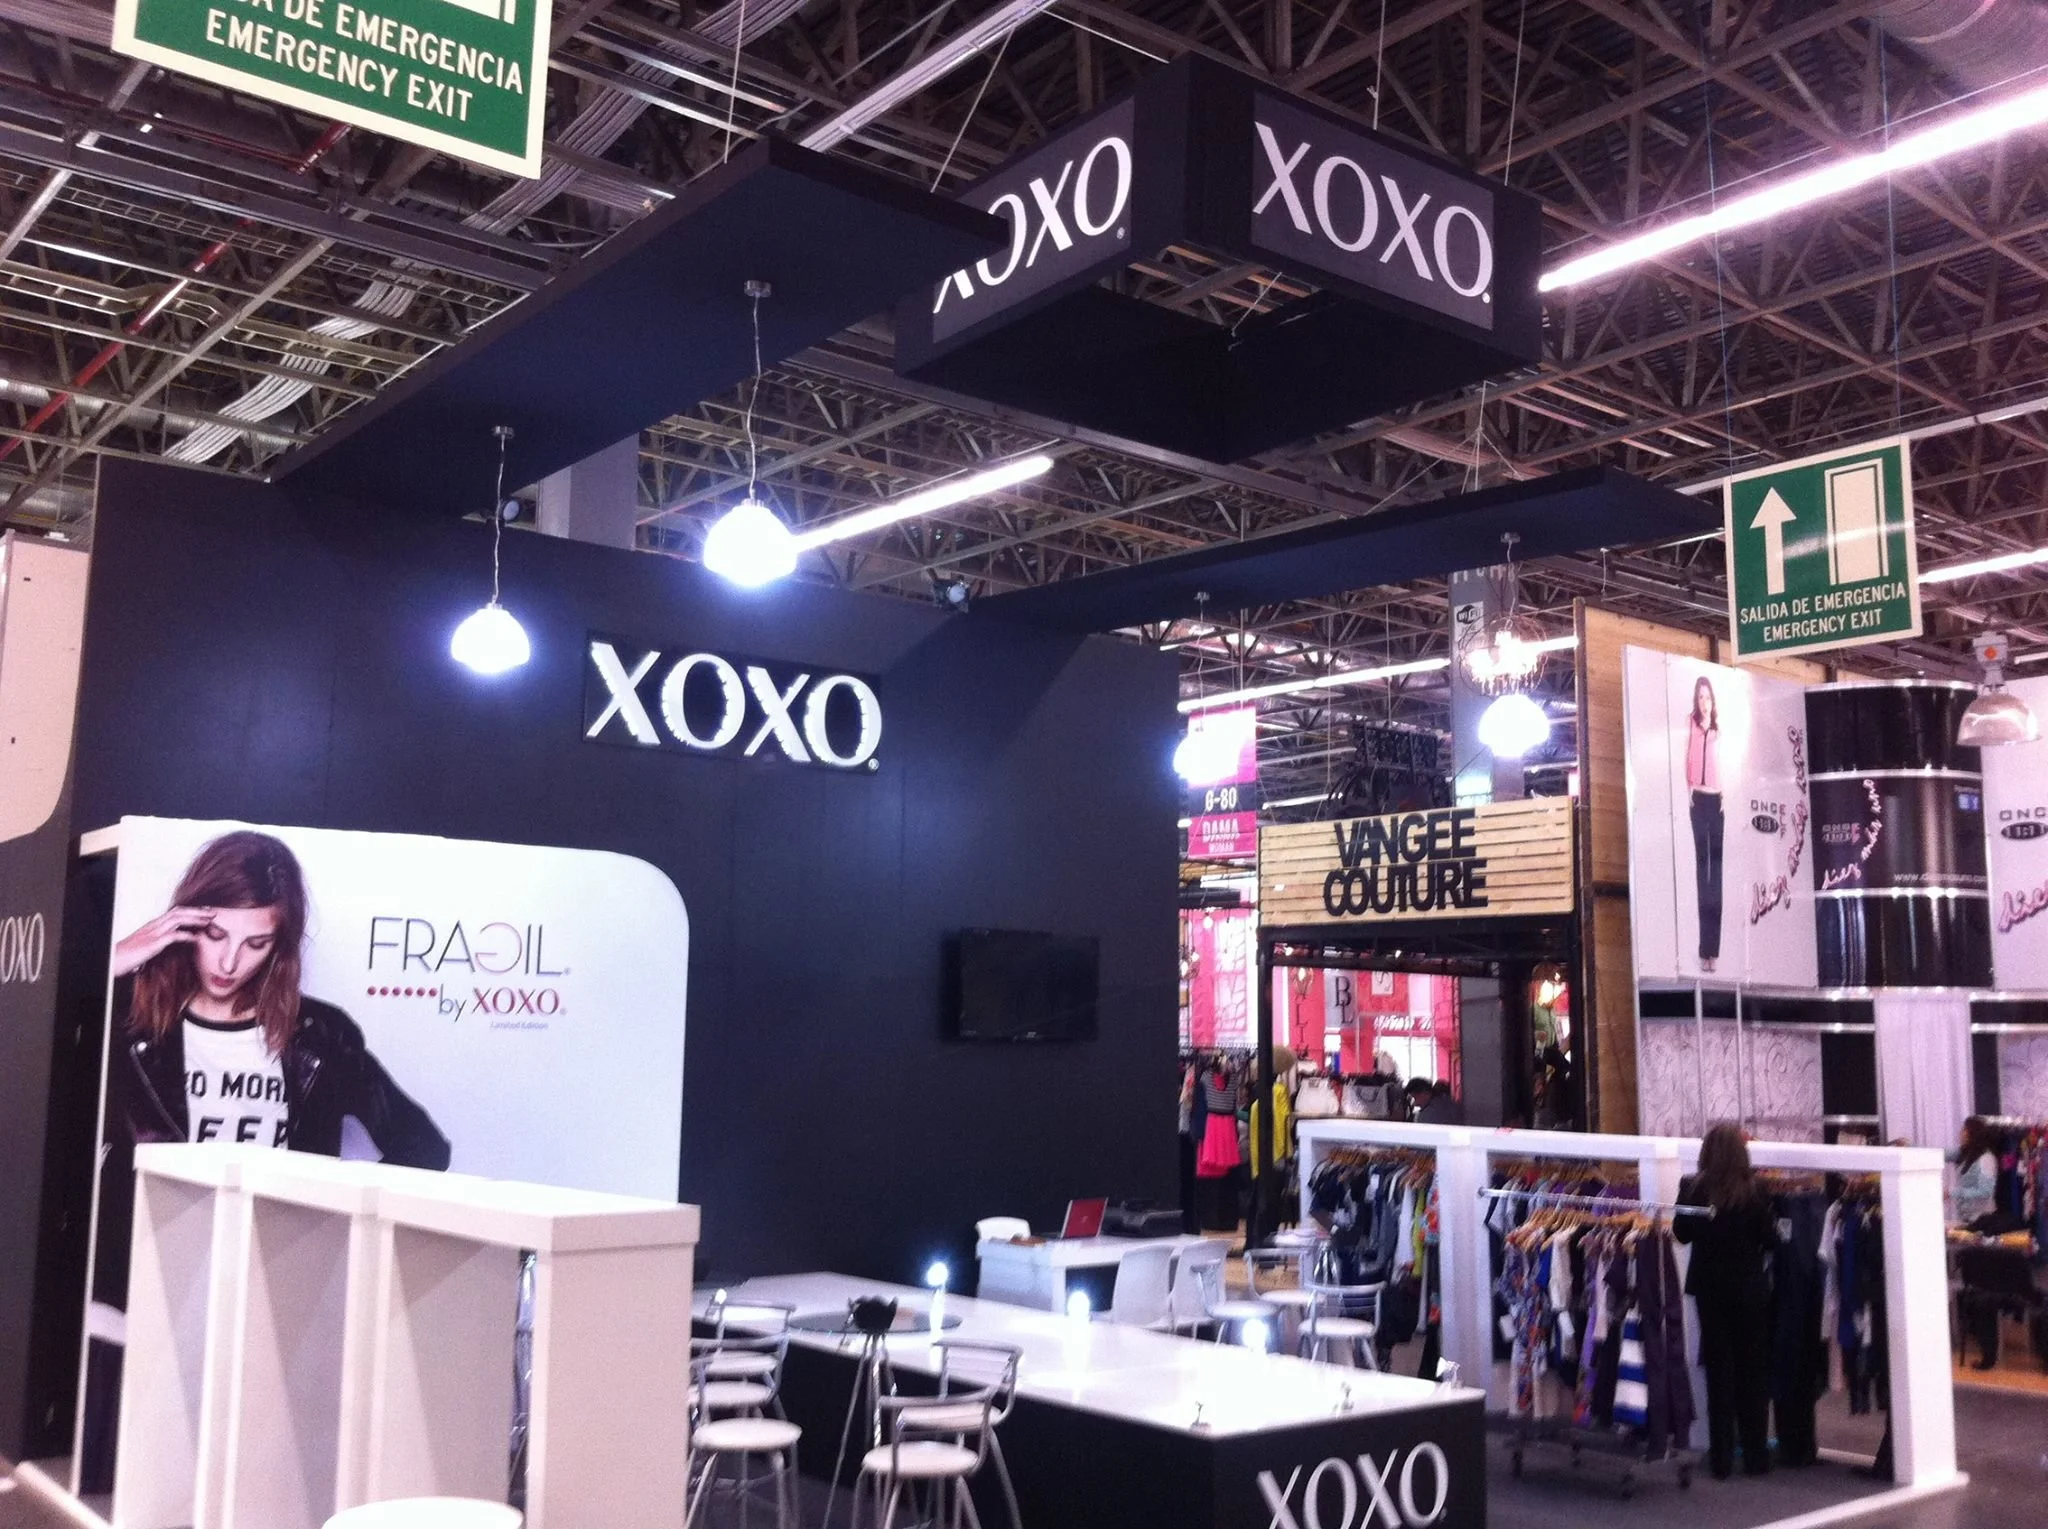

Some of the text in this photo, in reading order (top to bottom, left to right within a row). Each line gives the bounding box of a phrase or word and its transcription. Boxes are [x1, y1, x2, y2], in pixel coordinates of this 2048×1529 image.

[206, 8, 473, 122] EMERGENCY EXIT
[336, 3, 523, 95] EMERGENCIA
[1253, 121, 1493, 302] XOXO
[1740, 583, 1906, 625] SALIDA DE EMERGENCIA
[1764, 609, 1882, 643] EMERGENCY EXIT
[586, 641, 883, 770] XOXO
[1334, 808, 1476, 866] VANGEE
[1323, 859, 1488, 917] COUTURE
[0, 911, 45, 984] OXO
[438, 984, 560, 1023] by XOXO
